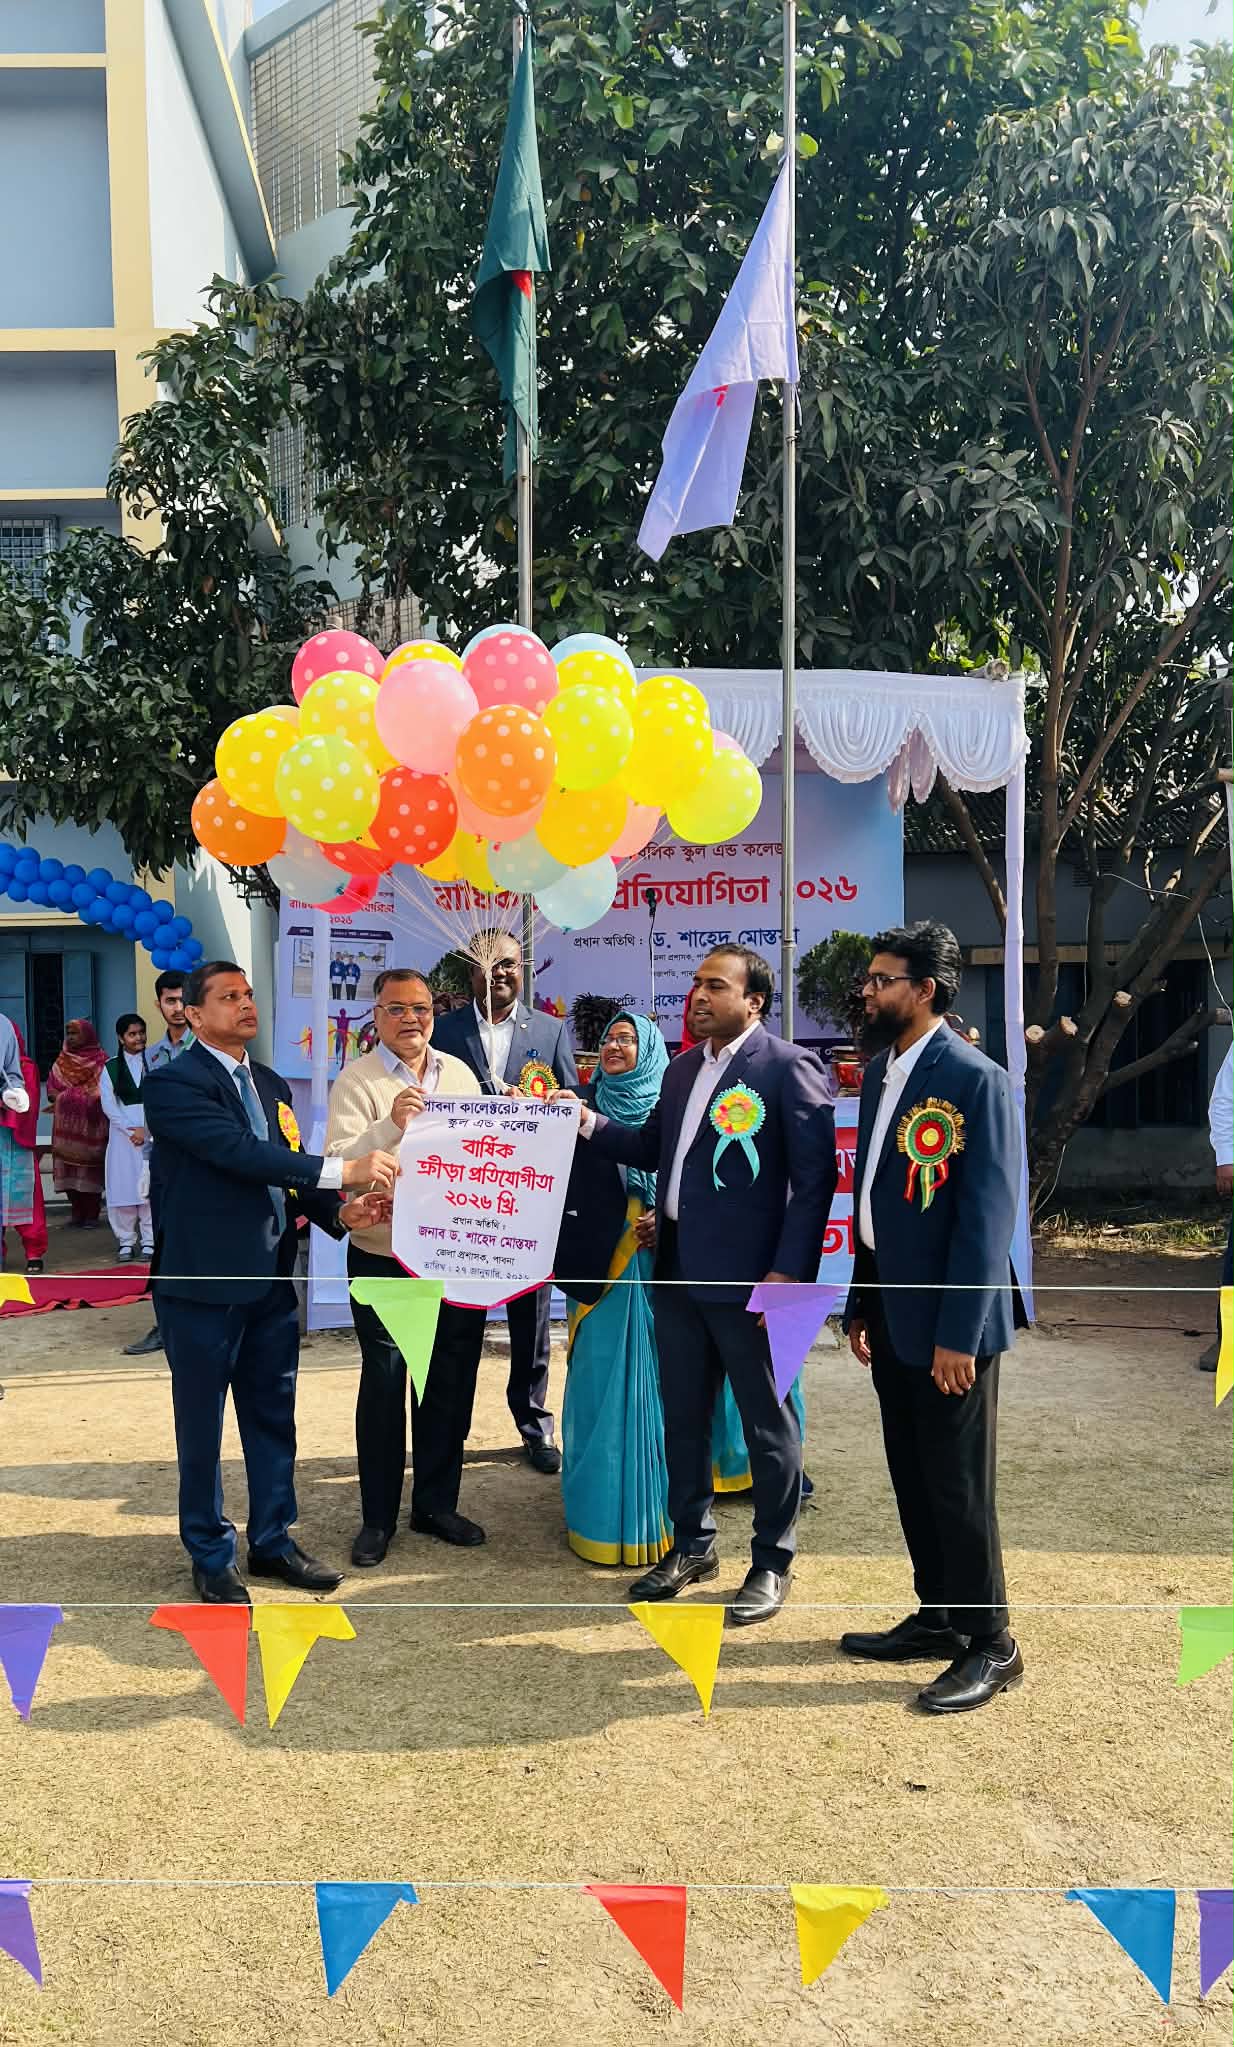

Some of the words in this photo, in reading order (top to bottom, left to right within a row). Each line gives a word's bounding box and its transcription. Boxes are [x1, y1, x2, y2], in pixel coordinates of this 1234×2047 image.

[611, 870, 770, 910] প্রতিযোগিতা
[779, 875, 858, 903] ০২৬
[574, 935, 600, 948] প্রধান
[604, 933, 635, 947] অতিথি
[653, 931, 671, 949] ড.
[678, 929, 732, 948] শাহেদ
[423, 1100, 456, 1113] পাবনা
[460, 1101, 519, 1116] কালেক্টরেট
[500, 1119, 540, 1134] কলেজ
[462, 1135, 516, 1159] বার্ষিক
[416, 1154, 466, 1183] ক্রীড়া
[468, 1161, 554, 1193] প্রতিযোগীতা
[444, 1190, 492, 1209] ২০২৬
[497, 1190, 519, 1216] খ্রি.
[452, 1216, 472, 1226] প্রধান
[475, 1218, 501, 1230] অতিথি
[418, 1225, 445, 1241] জনাব
[450, 1230, 461, 1243] ড.
[466, 1231, 497, 1247] শাহেদ
[501, 1236, 538, 1252] মোস্তফা
[493, 1256, 515, 1266] পাবনা
